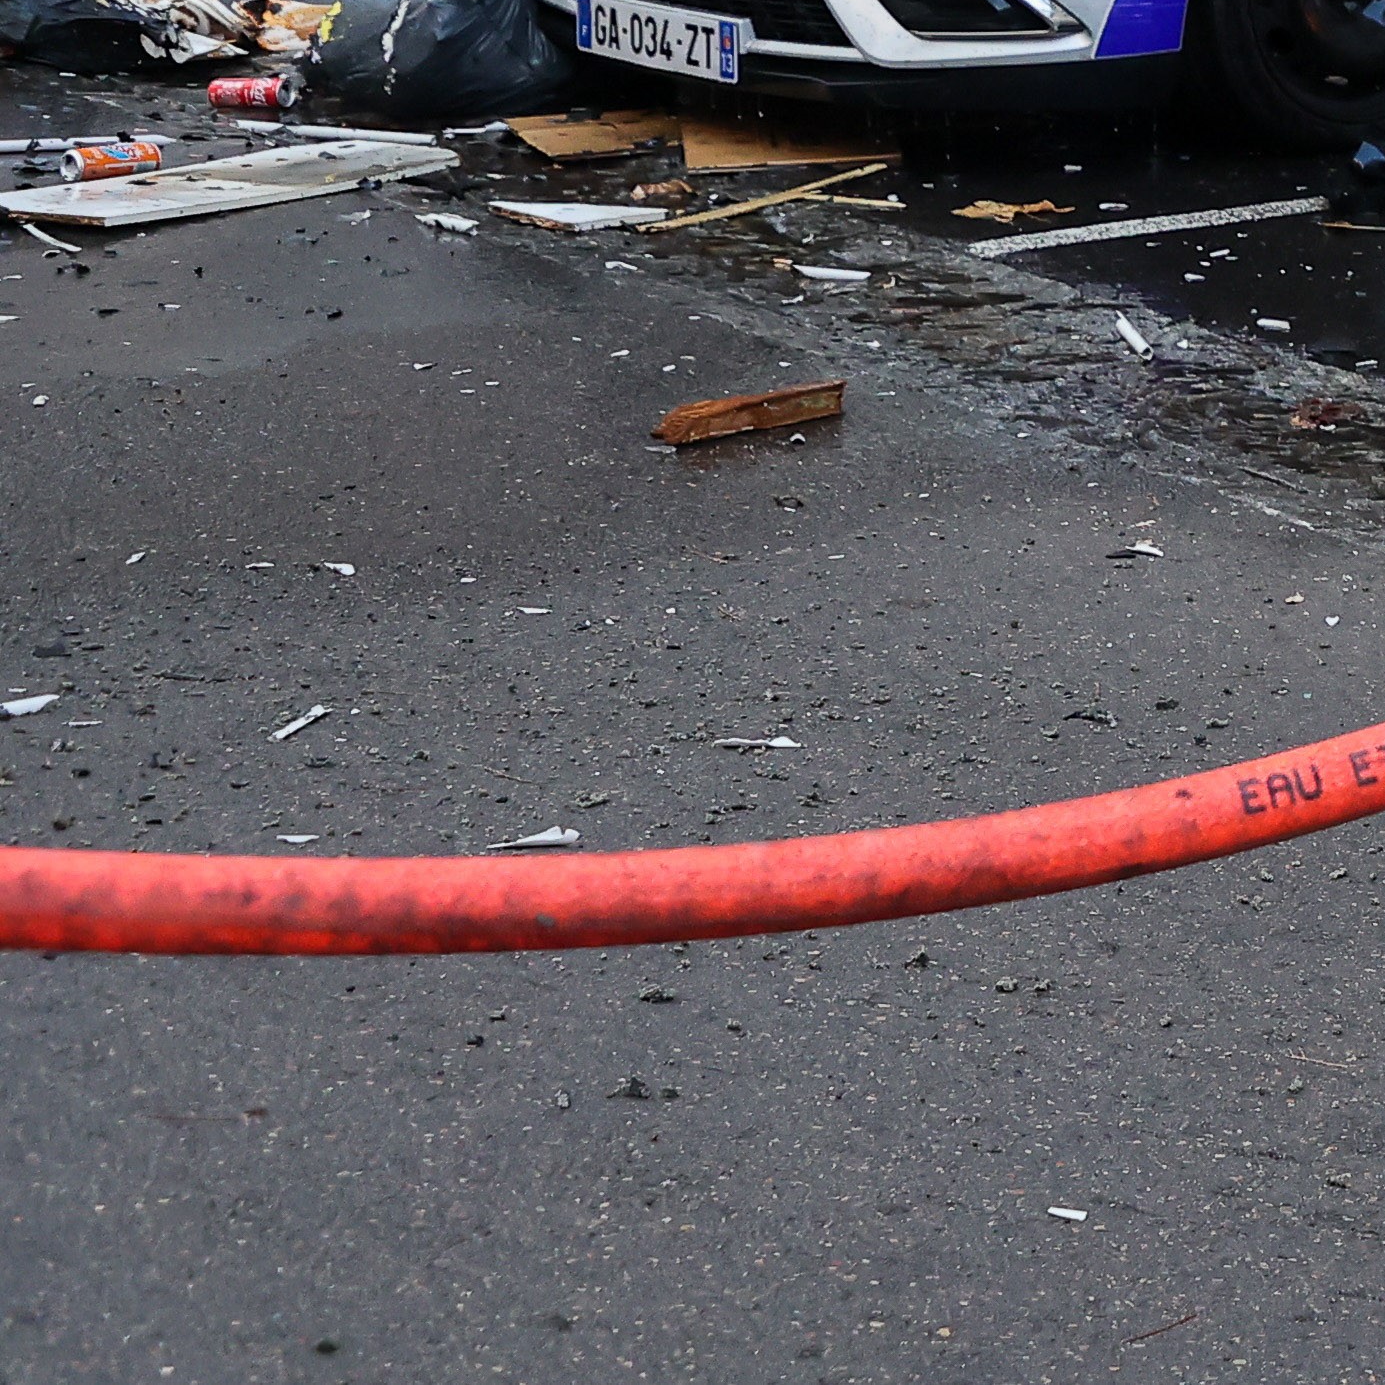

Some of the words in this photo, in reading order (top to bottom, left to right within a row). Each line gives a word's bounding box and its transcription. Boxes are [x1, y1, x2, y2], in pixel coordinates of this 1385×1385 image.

[594, 4, 715, 70] GA-034-ZT
[722, 53, 733, 74] 13
[1237, 764, 1324, 815] EAU
